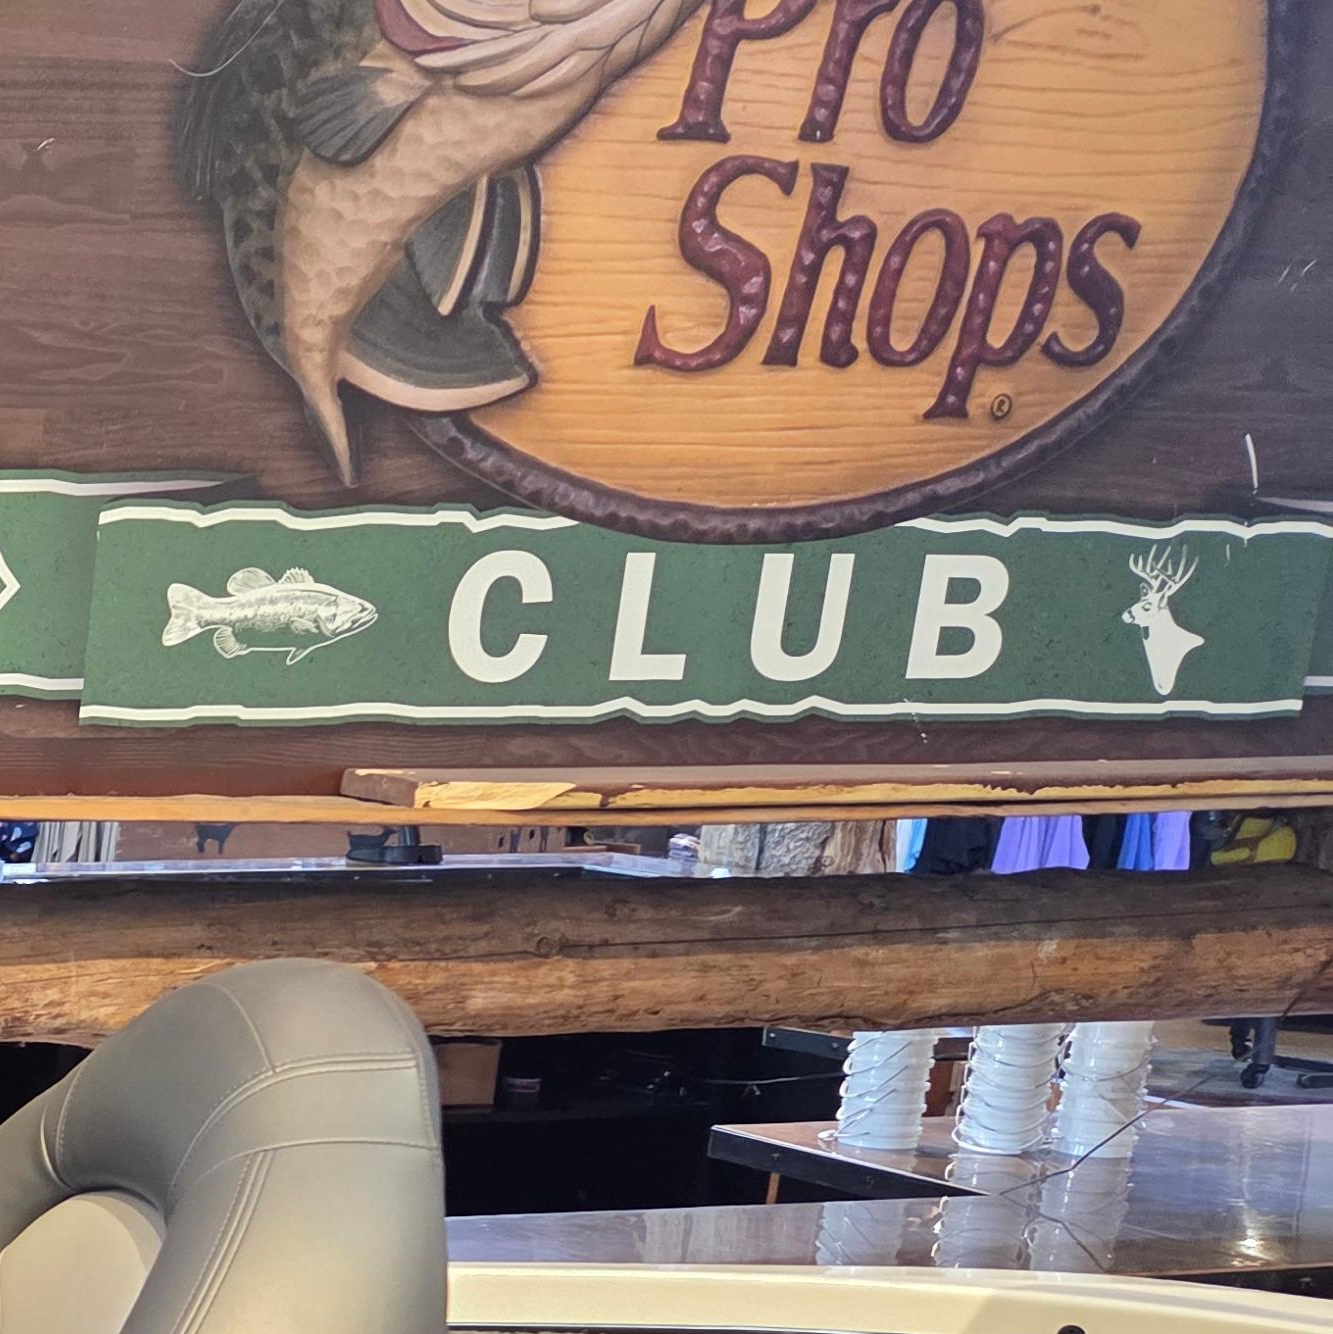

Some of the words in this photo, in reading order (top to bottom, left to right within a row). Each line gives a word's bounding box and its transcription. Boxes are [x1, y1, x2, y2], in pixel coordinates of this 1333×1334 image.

[657, 0, 985, 143] Pro
[634, 155, 1141, 420] Shops
[447, 550, 1007, 683] CLUB
